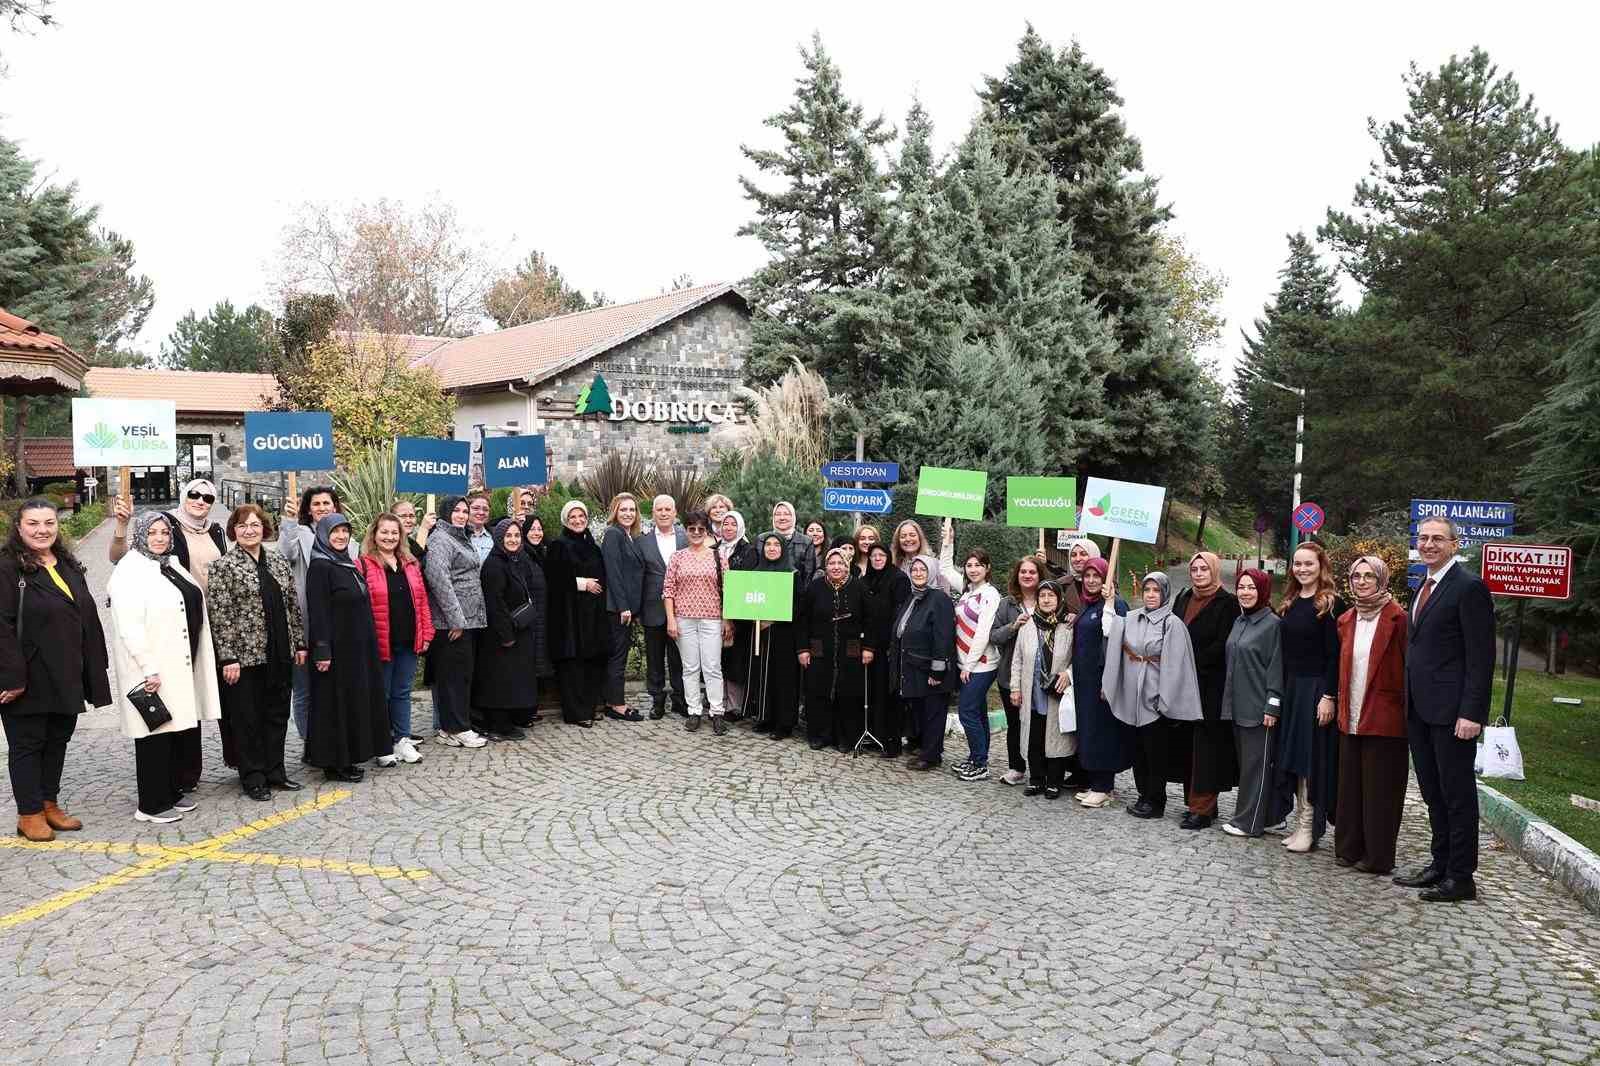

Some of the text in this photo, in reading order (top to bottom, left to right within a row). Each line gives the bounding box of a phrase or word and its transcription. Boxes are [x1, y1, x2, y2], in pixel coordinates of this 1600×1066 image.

[608, 398, 738, 423] DOBRUCA
[121, 424, 160, 438] YEŞİL
[122, 439, 168, 450] BURSA
[253, 433, 323, 450] GÜCÜNÜ
[400, 460, 467, 476] YERELDEN
[497, 456, 529, 470] ALAN
[830, 466, 887, 477] RESTORAN
[839, 495, 883, 506] OTOPARK
[1013, 496, 1072, 508] YOLCULUĞU
[1111, 506, 1150, 521] GREEN
[1418, 503, 1506, 520] SPOR ALANLARI
[1470, 526, 1505, 538] SAHASI
[1488, 548, 1566, 566] DİKKAT !!!
[1487, 564, 1515, 573] PİKNİK
[1517, 566, 1552, 576] YAPMAK
[1490, 574, 1561, 585] MANGAL YAKMAK
[1504, 583, 1545, 593] YASAKTIR
[745, 591, 766, 604] BİR
